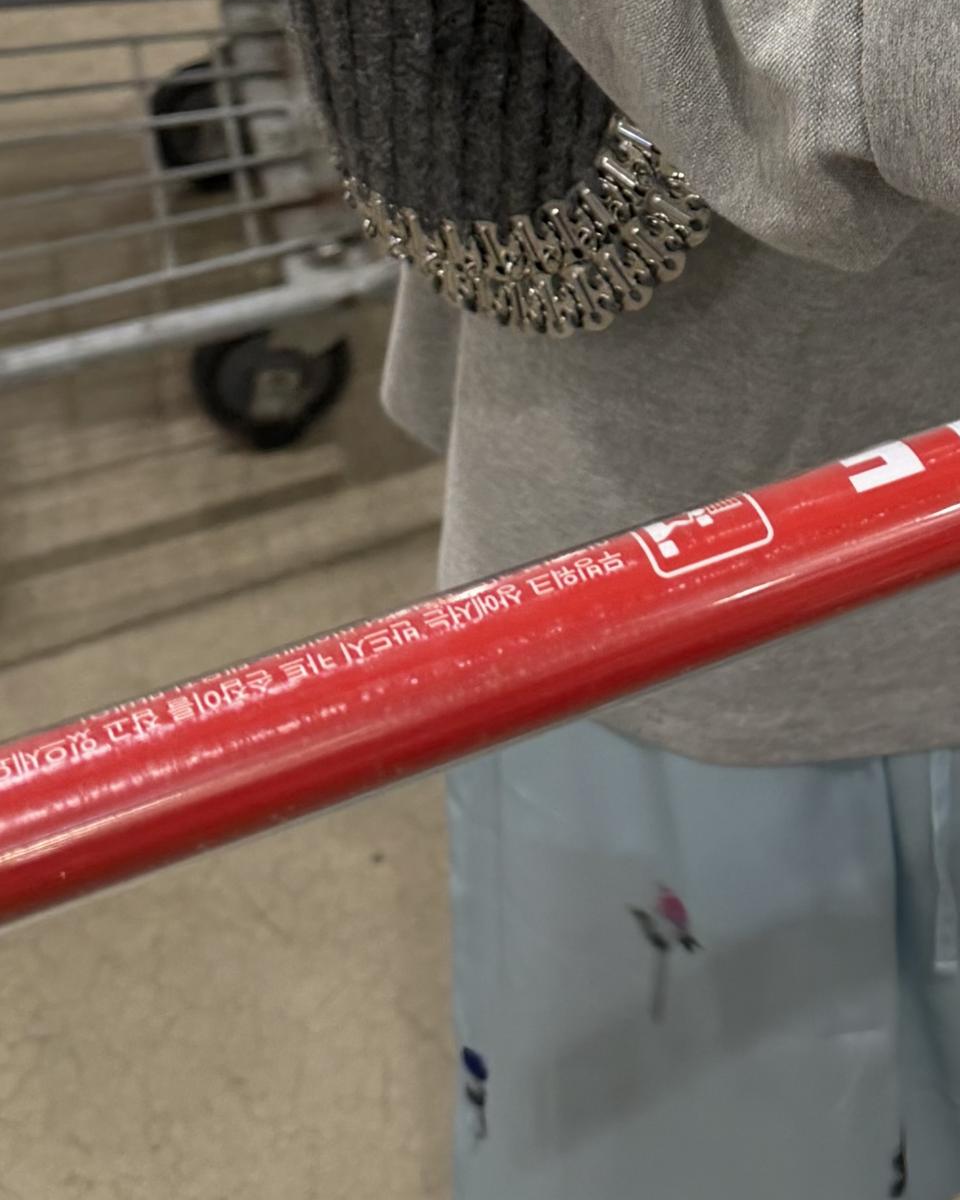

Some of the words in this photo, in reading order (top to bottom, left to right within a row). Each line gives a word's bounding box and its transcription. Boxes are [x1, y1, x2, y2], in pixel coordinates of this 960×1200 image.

[525, 550, 626, 596] 무빙워크
[423, 583, 522, 632] 상에서는
[279, 652, 337, 678] 카트
[338, 619, 421, 666] 반드시
[167, 668, 273, 722] 손잡이를
[102, 707, 158, 743] 잡고
